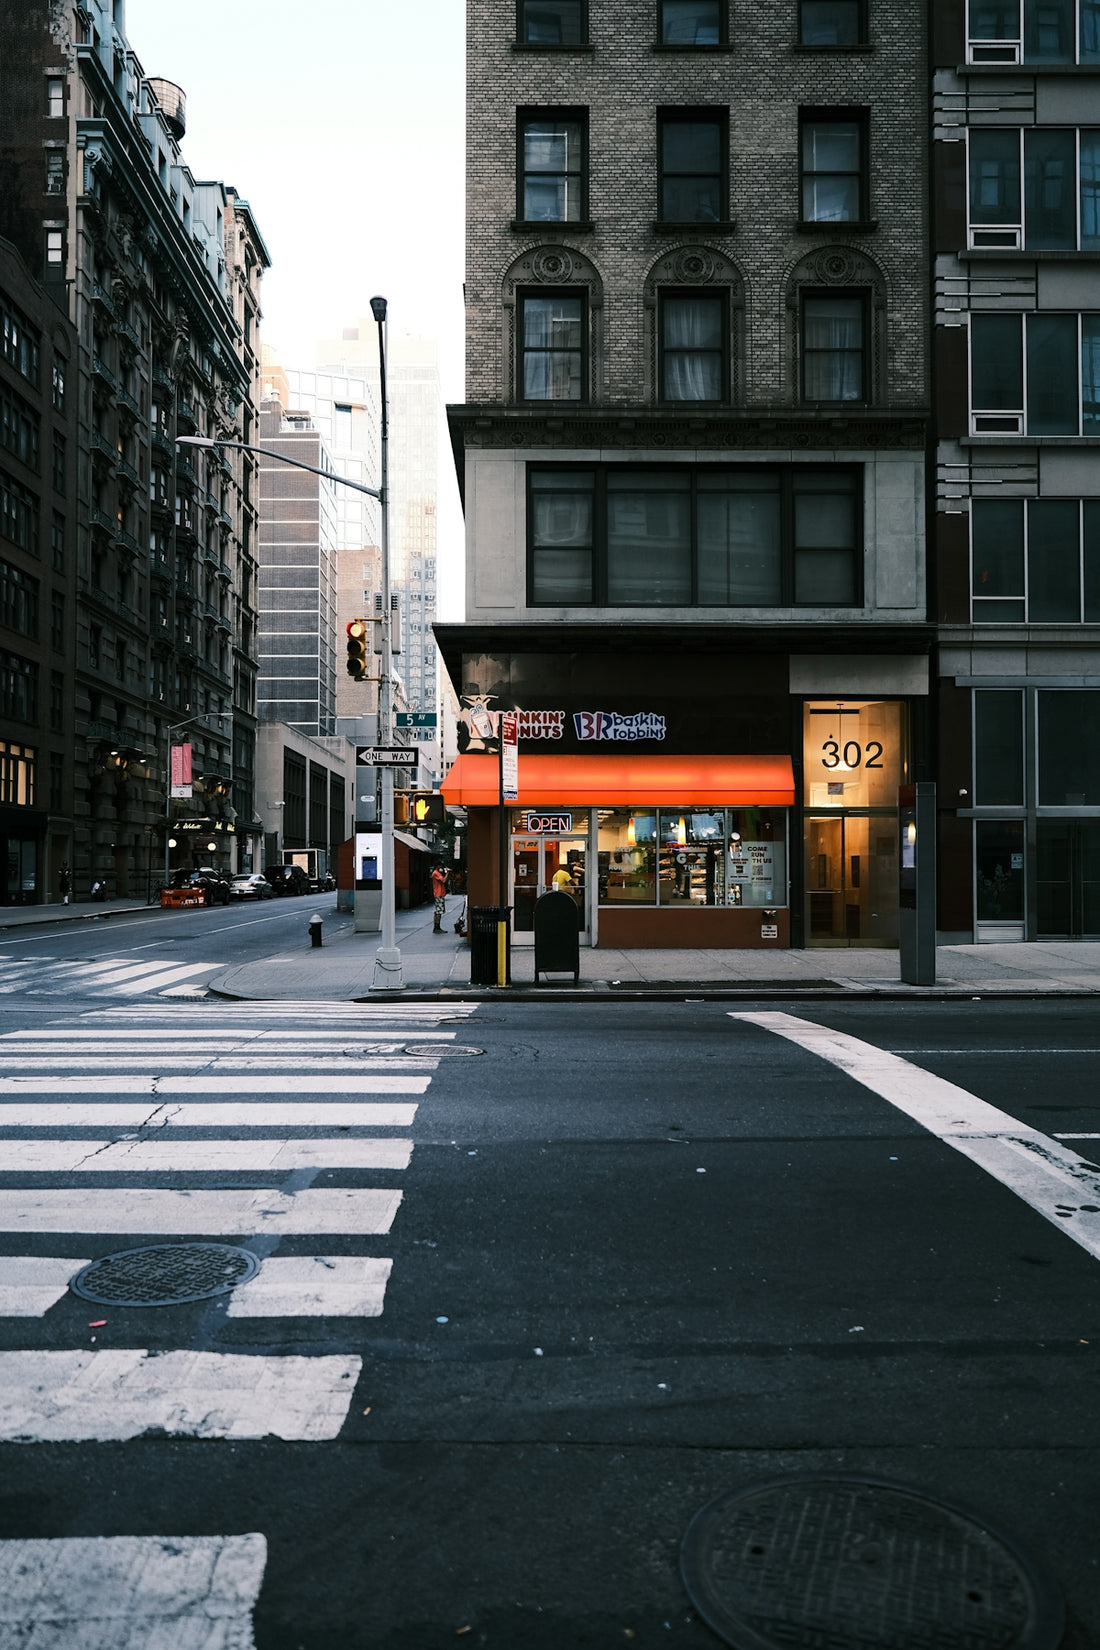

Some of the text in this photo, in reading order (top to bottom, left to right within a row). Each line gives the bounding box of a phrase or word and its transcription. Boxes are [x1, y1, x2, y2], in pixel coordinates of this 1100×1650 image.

[406, 714, 414, 726] 5
[516, 725, 562, 738] NUTS
[365, 752, 411, 761] ONE WAY
[821, 740, 884, 768] 302
[529, 817, 569, 832] OPEN
